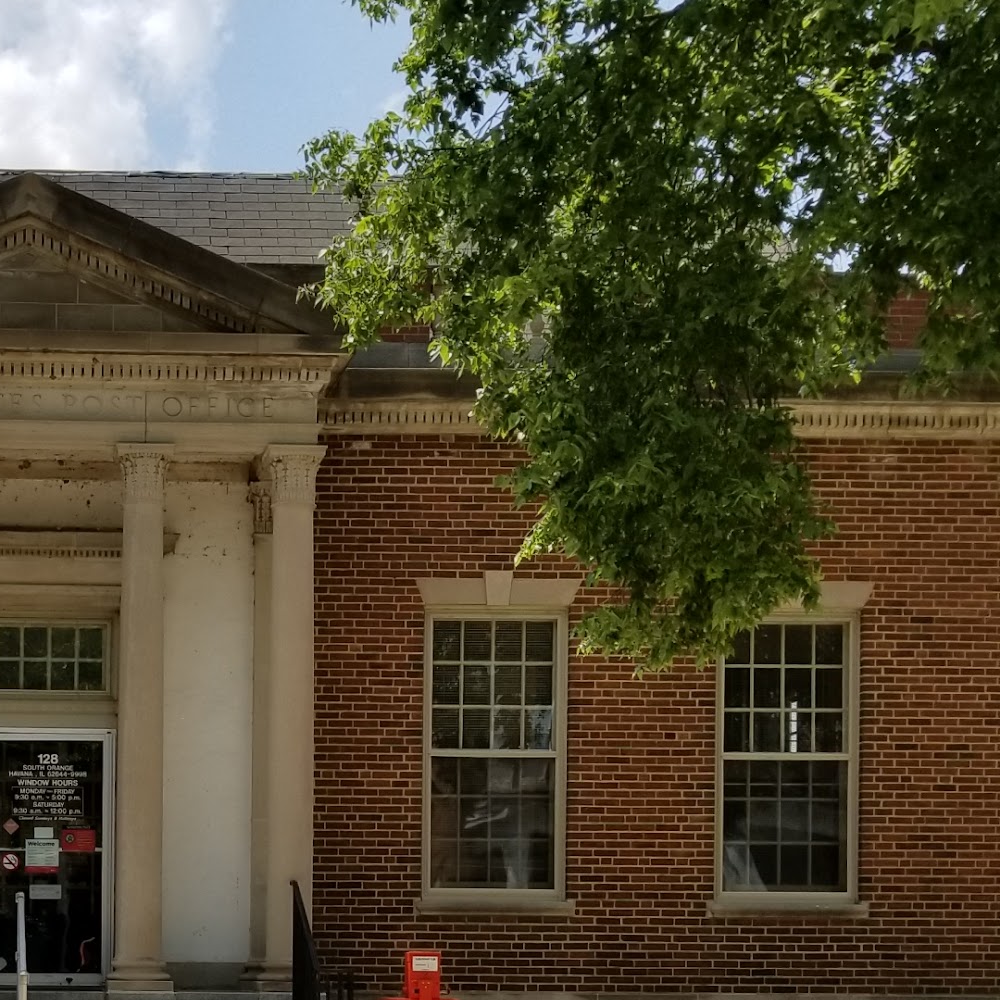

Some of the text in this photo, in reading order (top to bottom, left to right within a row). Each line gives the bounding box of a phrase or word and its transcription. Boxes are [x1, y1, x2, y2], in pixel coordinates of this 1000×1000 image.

[62, 393, 143, 414] POST
[162, 396, 274, 418] OFFICE
[37, 753, 59, 765] 128
[46, 764, 74, 772] ORANGE
[52, 779, 78, 787] HOURS
